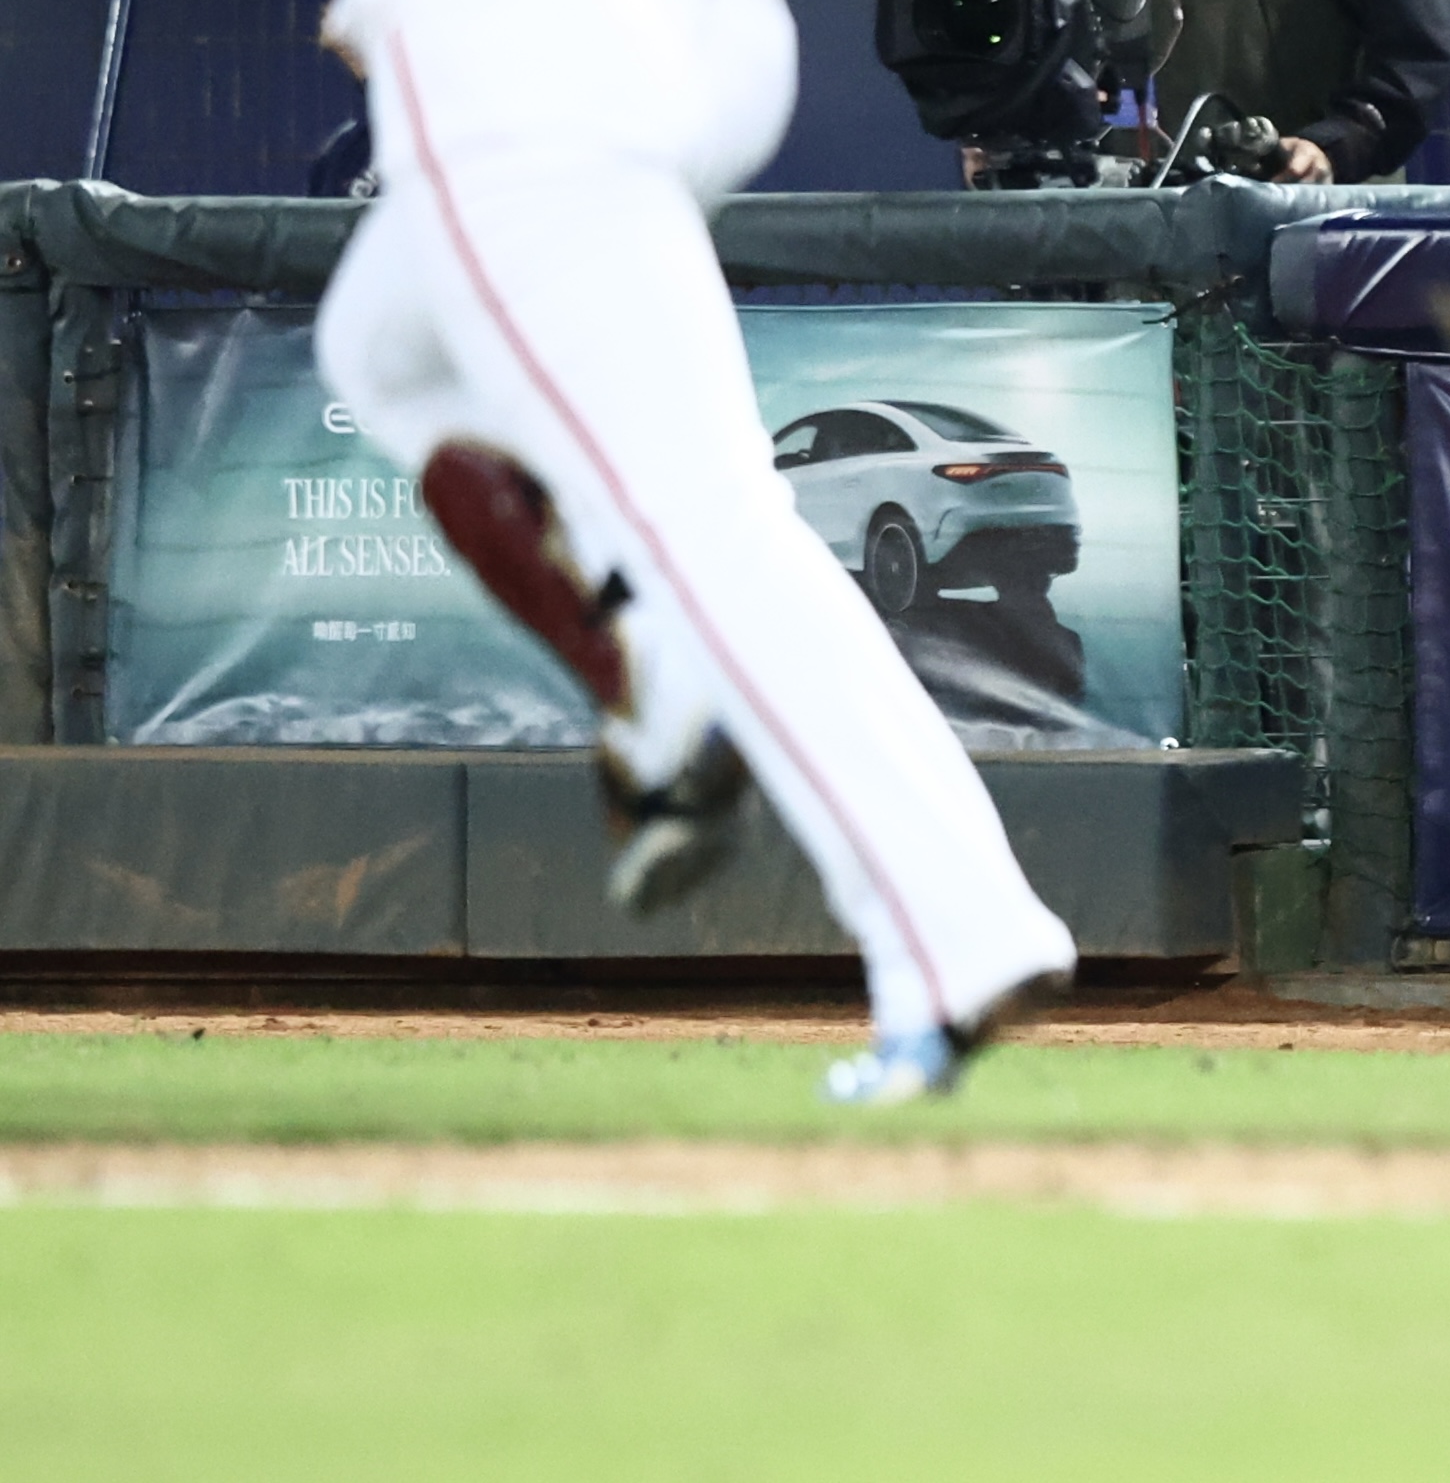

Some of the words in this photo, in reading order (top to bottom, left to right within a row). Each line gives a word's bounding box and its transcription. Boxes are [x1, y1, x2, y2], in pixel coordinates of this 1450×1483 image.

[284, 478, 353, 519] THIS
[359, 478, 386, 519] IS
[392, 478, 426, 519] FO
[282, 536, 334, 577] ALL
[339, 536, 452, 578] SENSES.
